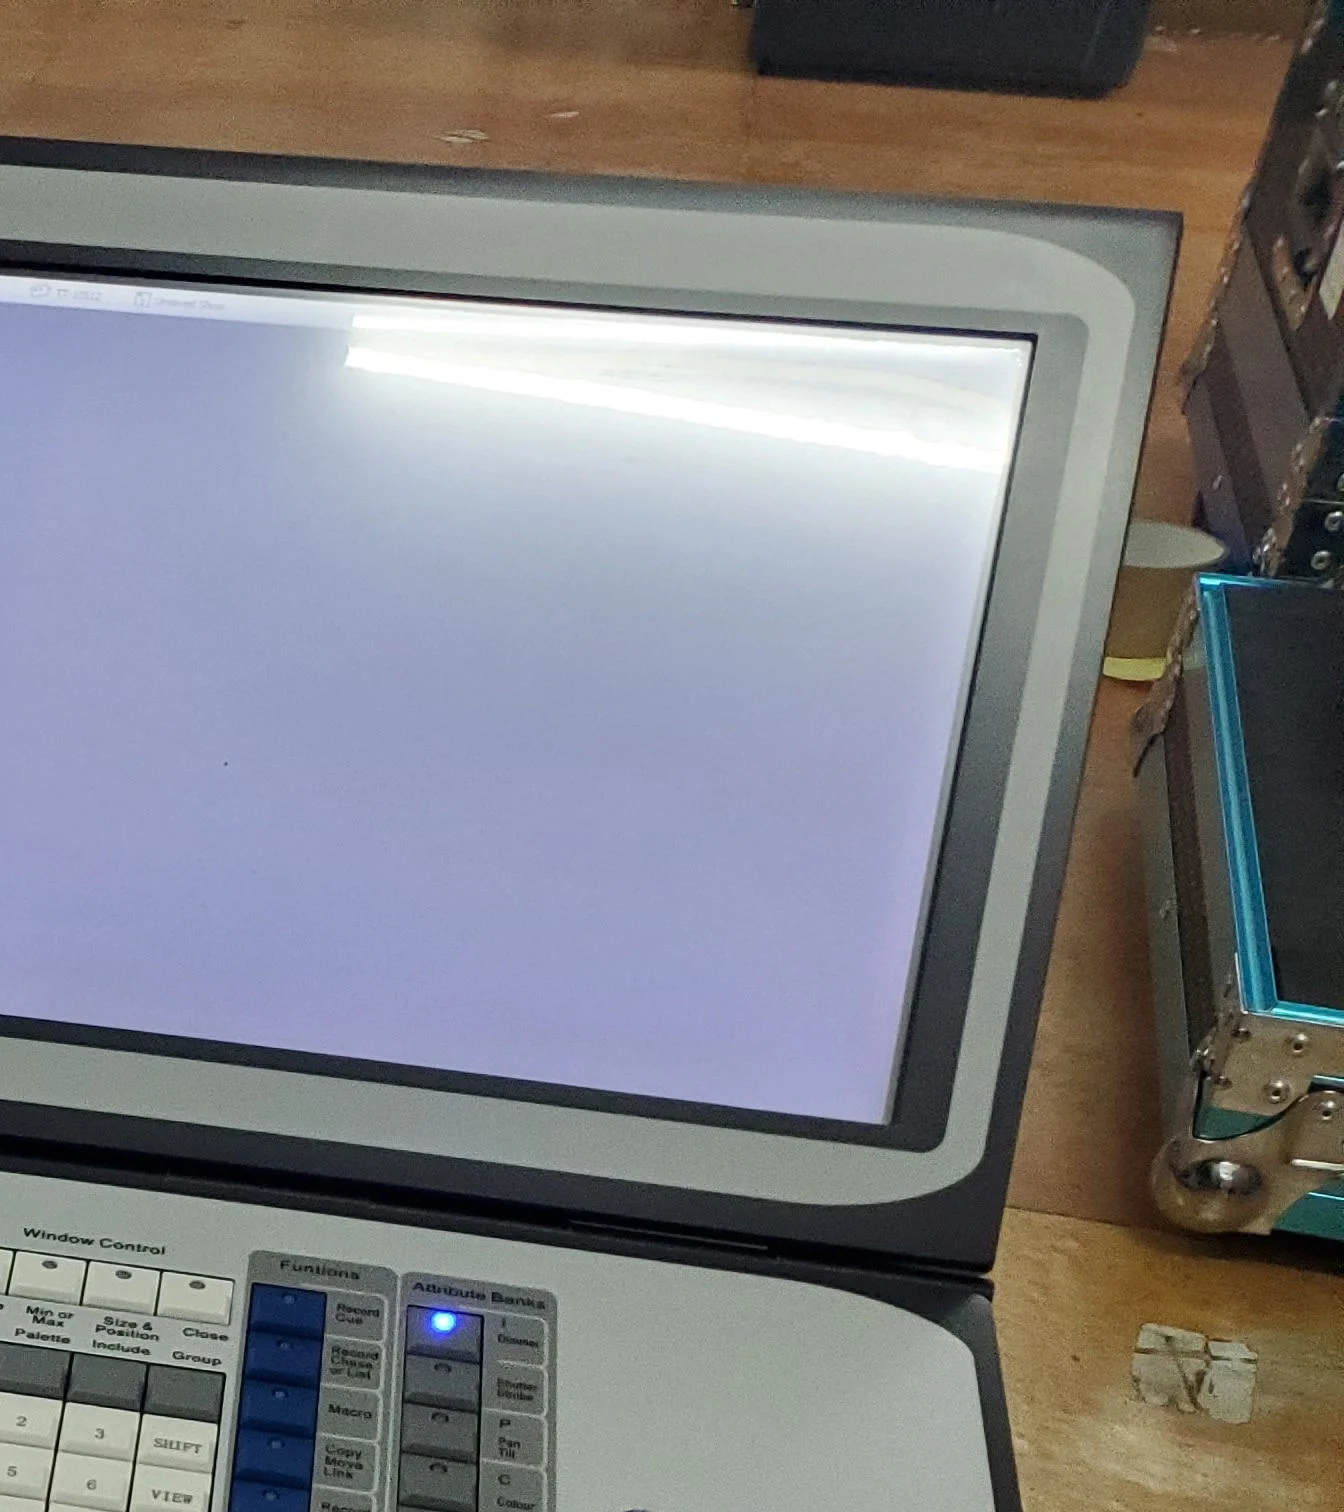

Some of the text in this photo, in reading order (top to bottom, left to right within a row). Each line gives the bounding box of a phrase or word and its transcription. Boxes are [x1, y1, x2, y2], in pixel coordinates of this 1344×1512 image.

[24, 1228, 165, 1255] Window Control
[413, 1282, 545, 1310] Attribute Banks
[26, 1305, 74, 1319] Min or
[336, 1304, 379, 1317] Record
[33, 1314, 64, 1328] Max
[103, 1316, 138, 1330] Size
[15, 1328, 70, 1346] Palette
[95, 1324, 159, 1341] Position
[183, 1328, 228, 1342] Close
[92, 1339, 151, 1355] Include
[331, 1346, 378, 1361] Record
[172, 1350, 221, 1366] Group
[328, 1404, 371, 1419] Macro
[16, 1416, 27, 1427] 2
[94, 1428, 105, 1439] 3
[154, 1437, 202, 1454] SHIFT
[326, 1444, 361, 1460] Copy
[324, 1467, 353, 1478] Link
[7, 1466, 16, 1477] 5
[86, 1478, 97, 1491] 6
[152, 1489, 193, 1504] VIEW
